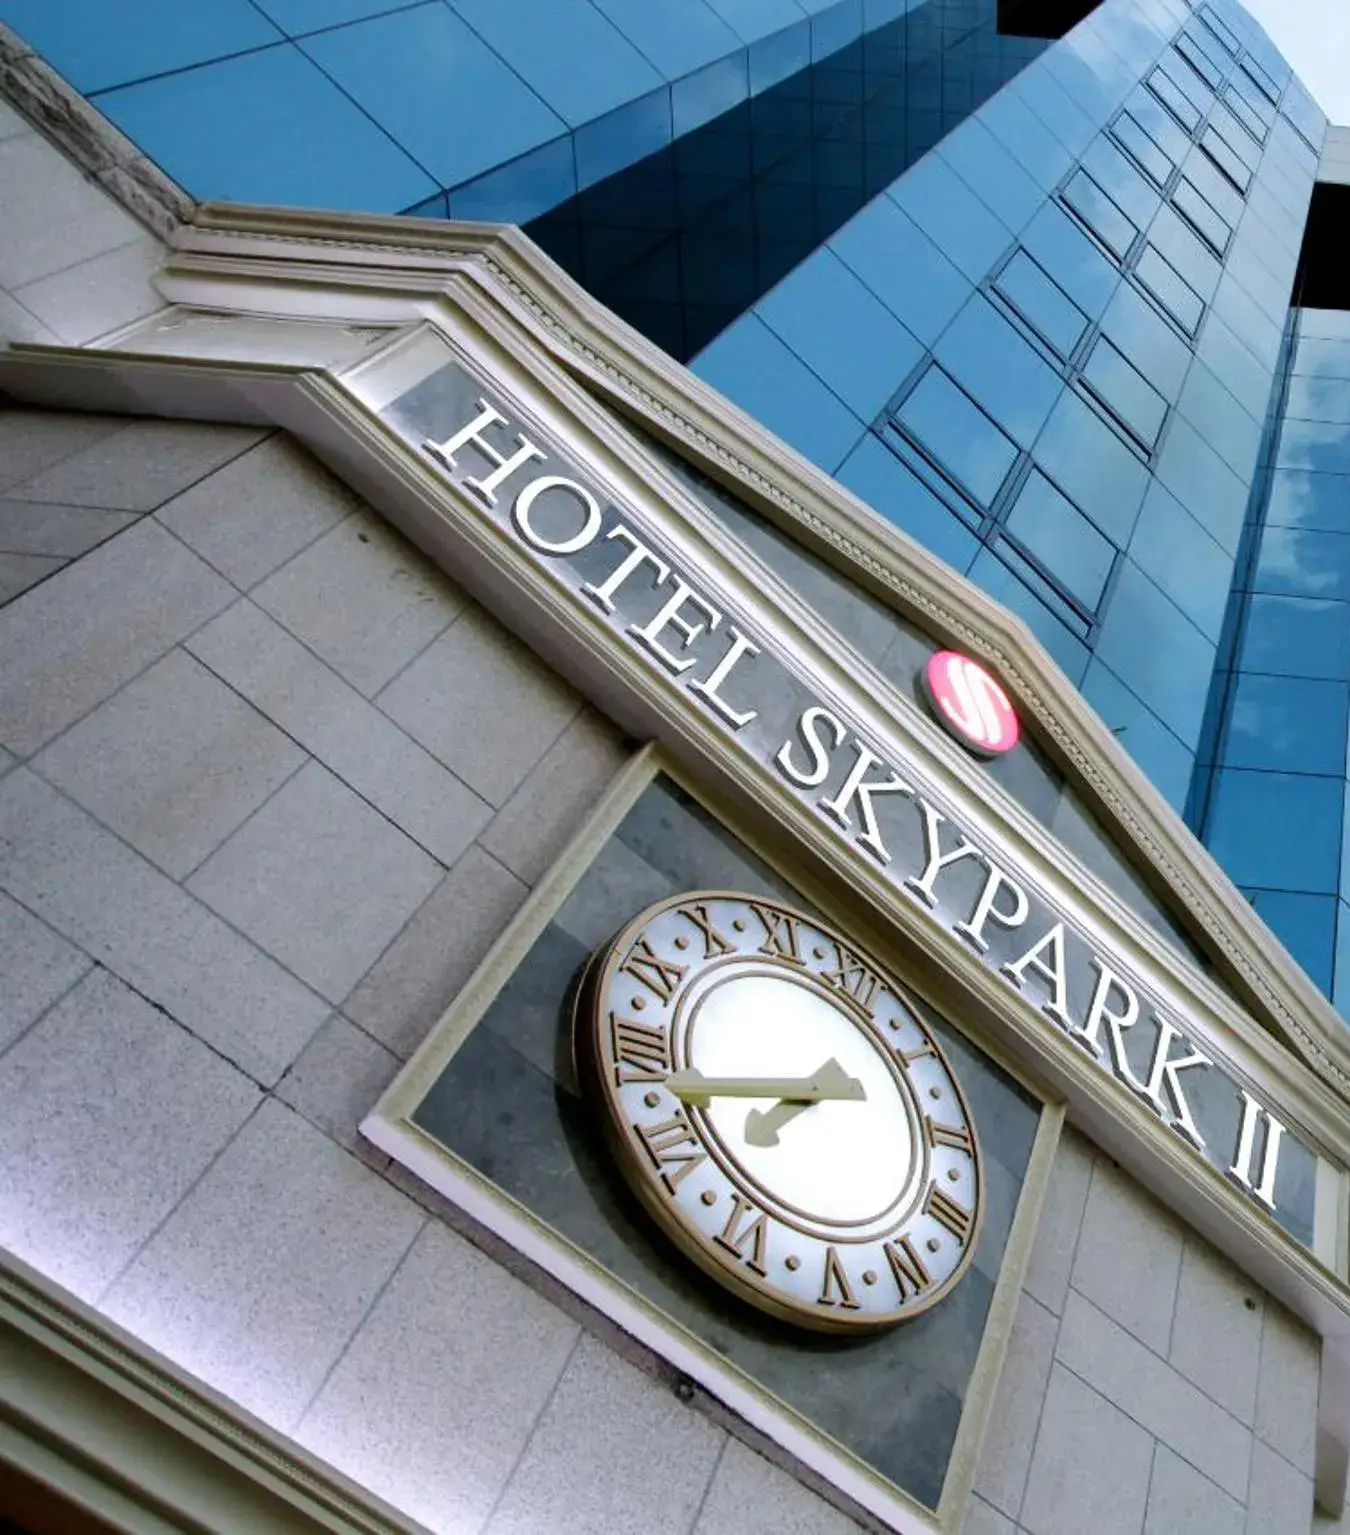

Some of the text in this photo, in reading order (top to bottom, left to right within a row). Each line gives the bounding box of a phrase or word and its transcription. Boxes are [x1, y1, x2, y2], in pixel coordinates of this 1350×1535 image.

[422, 398, 1288, 1210] HOTEL SKYPARK II
[678, 906, 736, 959] X
[750, 904, 806, 966] XI
[620, 933, 689, 1007] IX
[821, 940, 890, 1019] XII
[610, 1012, 668, 1087] VIII
[634, 1109, 707, 1196] VII
[925, 1115, 972, 1157] II
[713, 1194, 768, 1277] VI
[921, 1180, 970, 1245] III
[817, 1246, 860, 1309] V
[883, 1233, 936, 1304] IV
